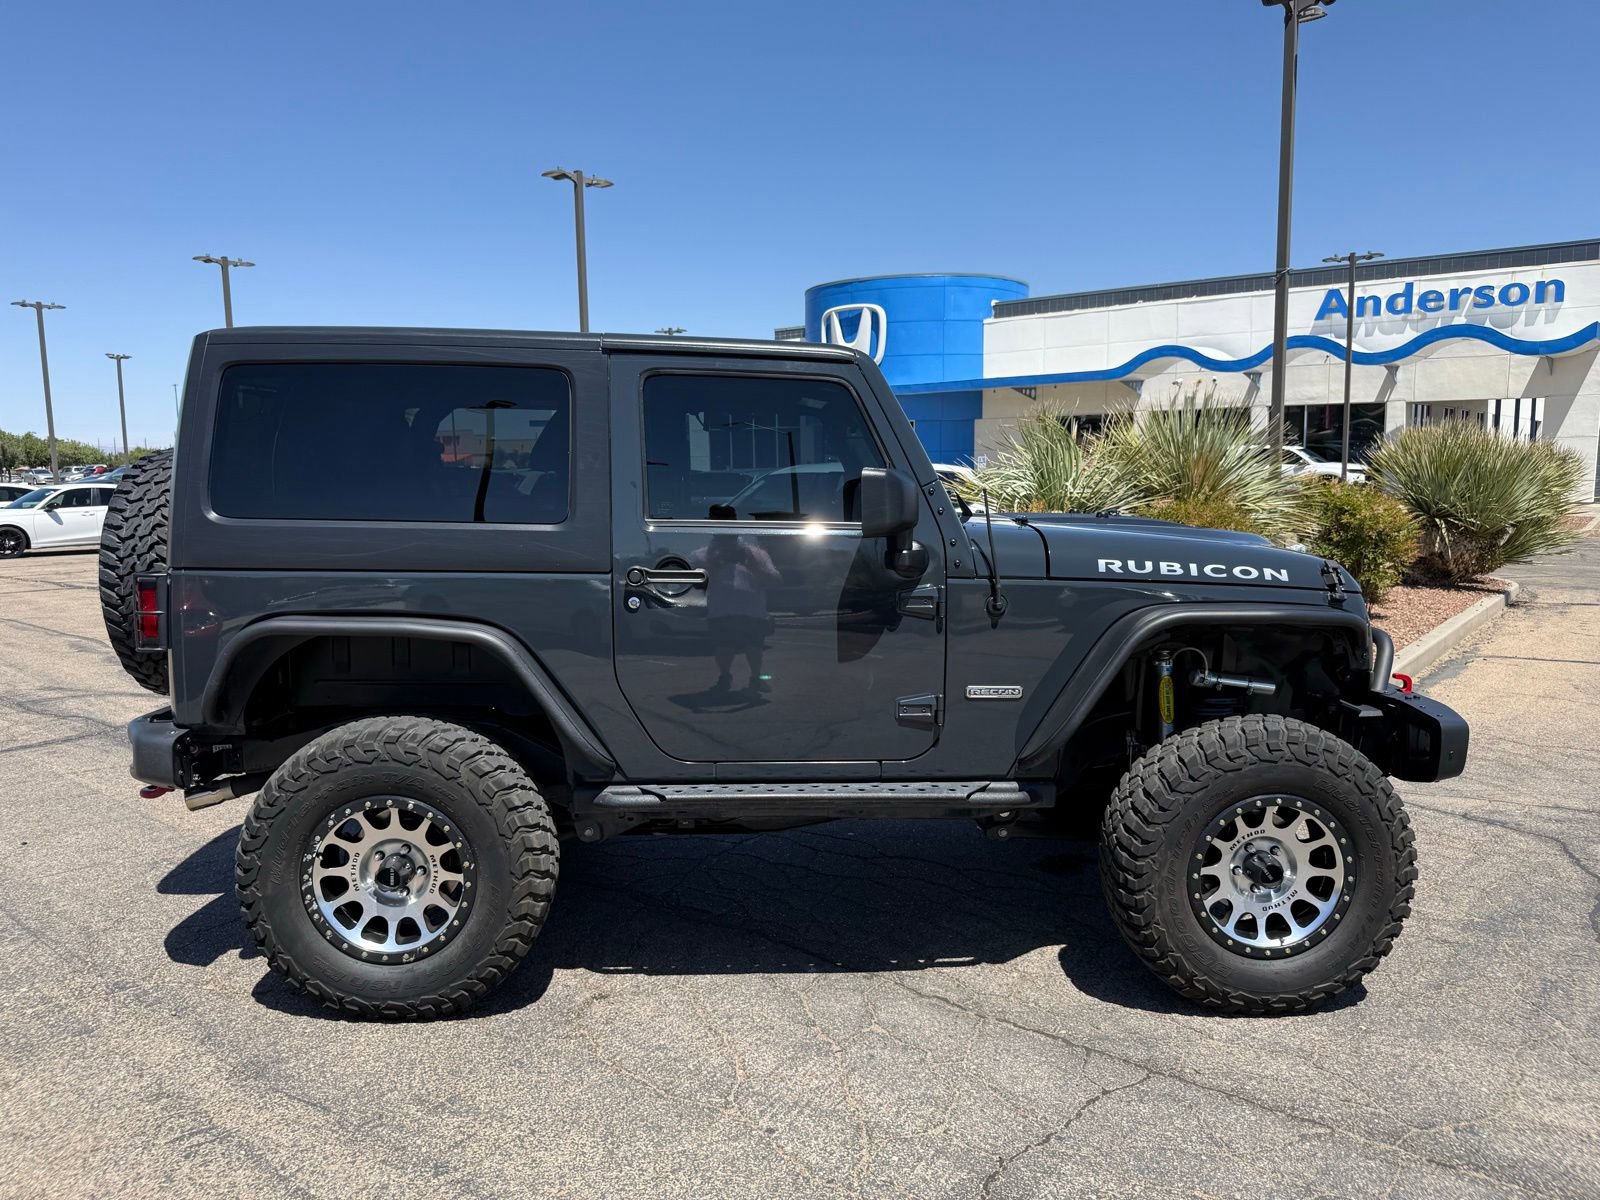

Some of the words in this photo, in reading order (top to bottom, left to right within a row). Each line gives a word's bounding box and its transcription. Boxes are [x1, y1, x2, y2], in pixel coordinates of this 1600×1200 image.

[1314, 278, 1566, 320] Anderson
[1097, 559, 1289, 582] RUBICON
[969, 688, 1020, 696] RECON
[1229, 829, 1266, 851] METHOD
[350, 852, 360, 892] METHOD
[429, 854, 439, 894] METHOD
